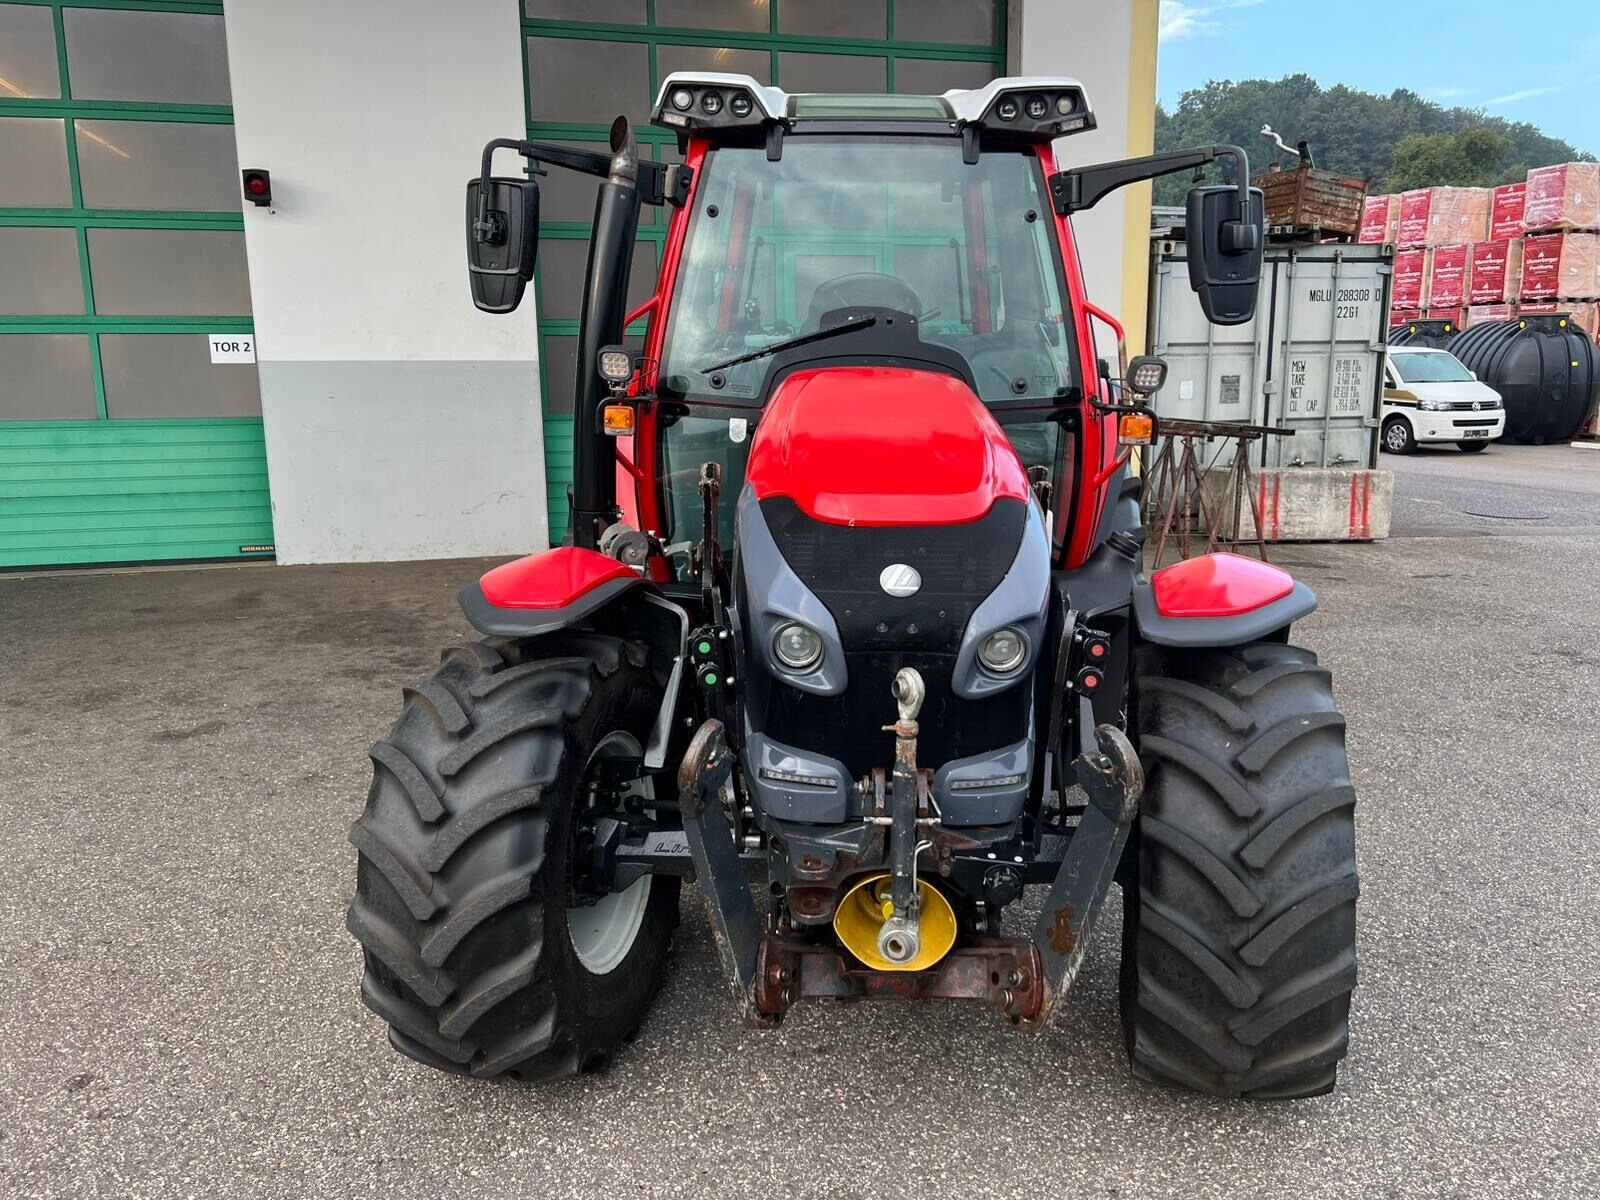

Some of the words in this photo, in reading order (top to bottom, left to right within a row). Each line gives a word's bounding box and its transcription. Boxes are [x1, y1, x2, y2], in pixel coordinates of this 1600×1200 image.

[1309, 289, 1331, 301] MGLU
[1337, 289, 1370, 301] 288308
[212, 342, 240, 352] TOR
[243, 342, 251, 352] 2
[1291, 373, 1305, 385] TARE
[1290, 387, 1302, 399] NET
